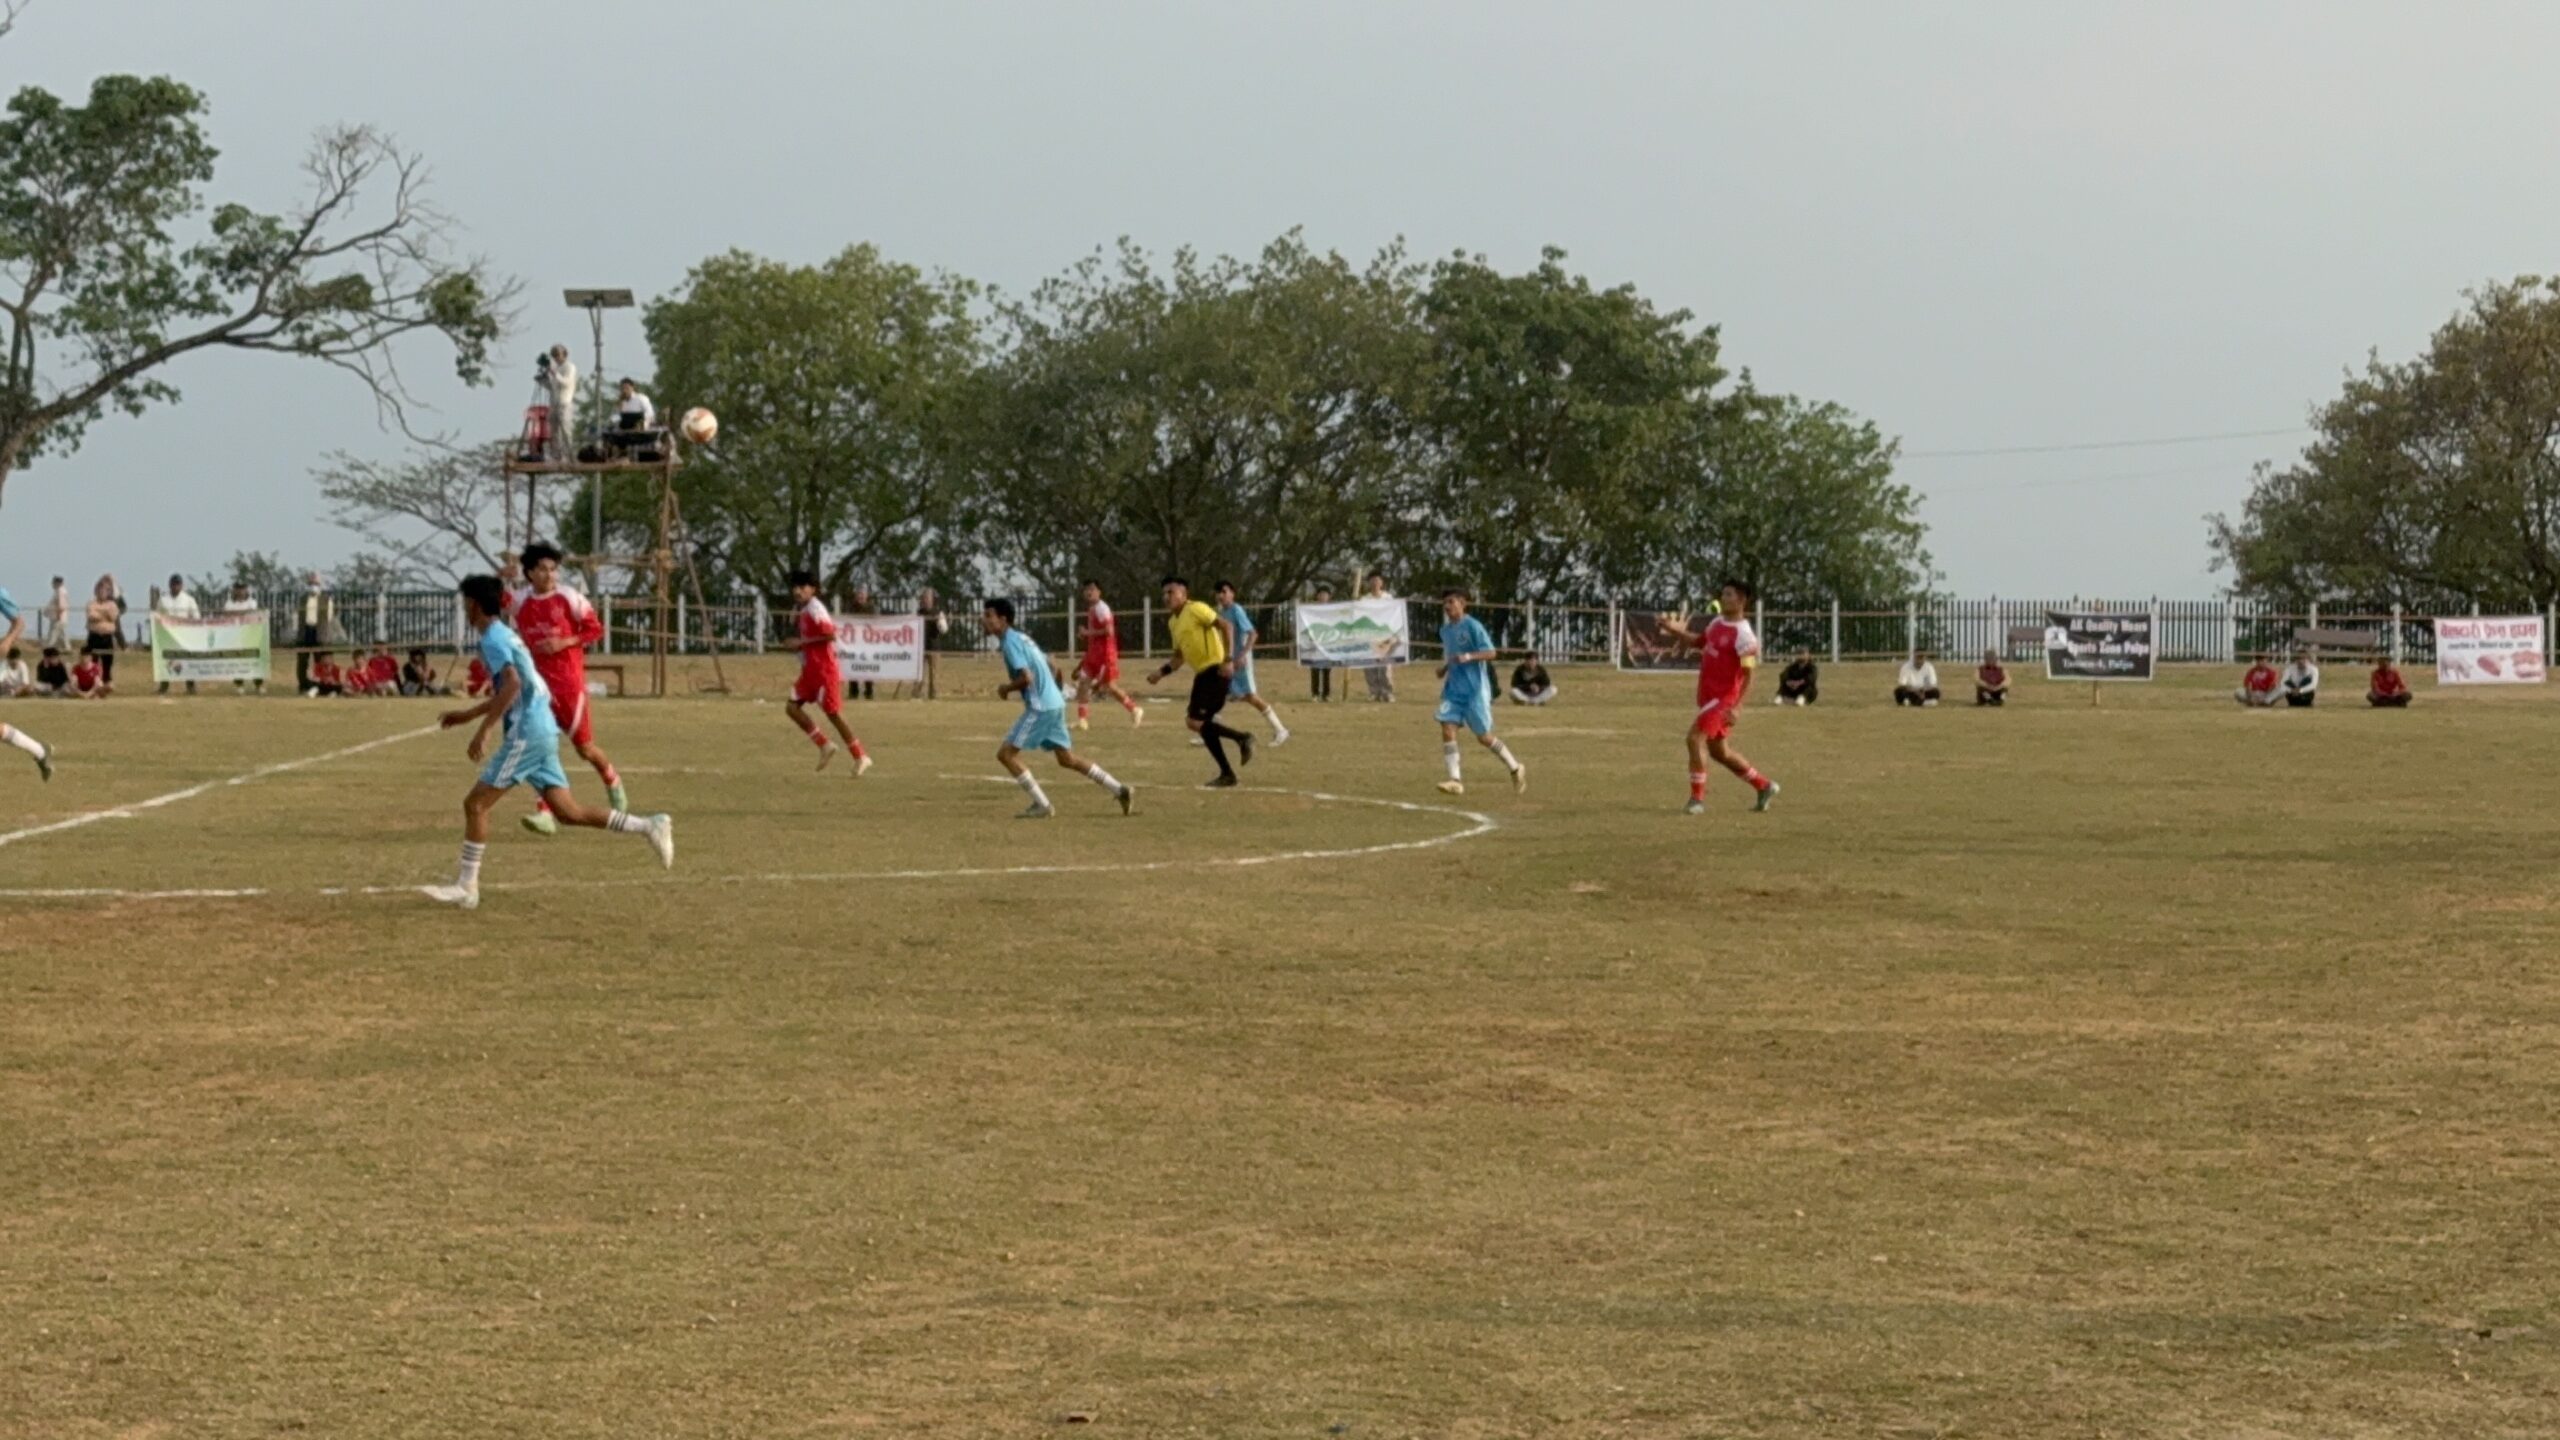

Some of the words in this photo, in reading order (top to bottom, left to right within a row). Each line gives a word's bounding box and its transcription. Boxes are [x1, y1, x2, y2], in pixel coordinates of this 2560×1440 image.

[2086, 618, 2118, 634] Quality
[2068, 641, 2097, 657] Sports
[2099, 641, 2121, 654] Zone
[2124, 641, 2149, 657] Palpa
